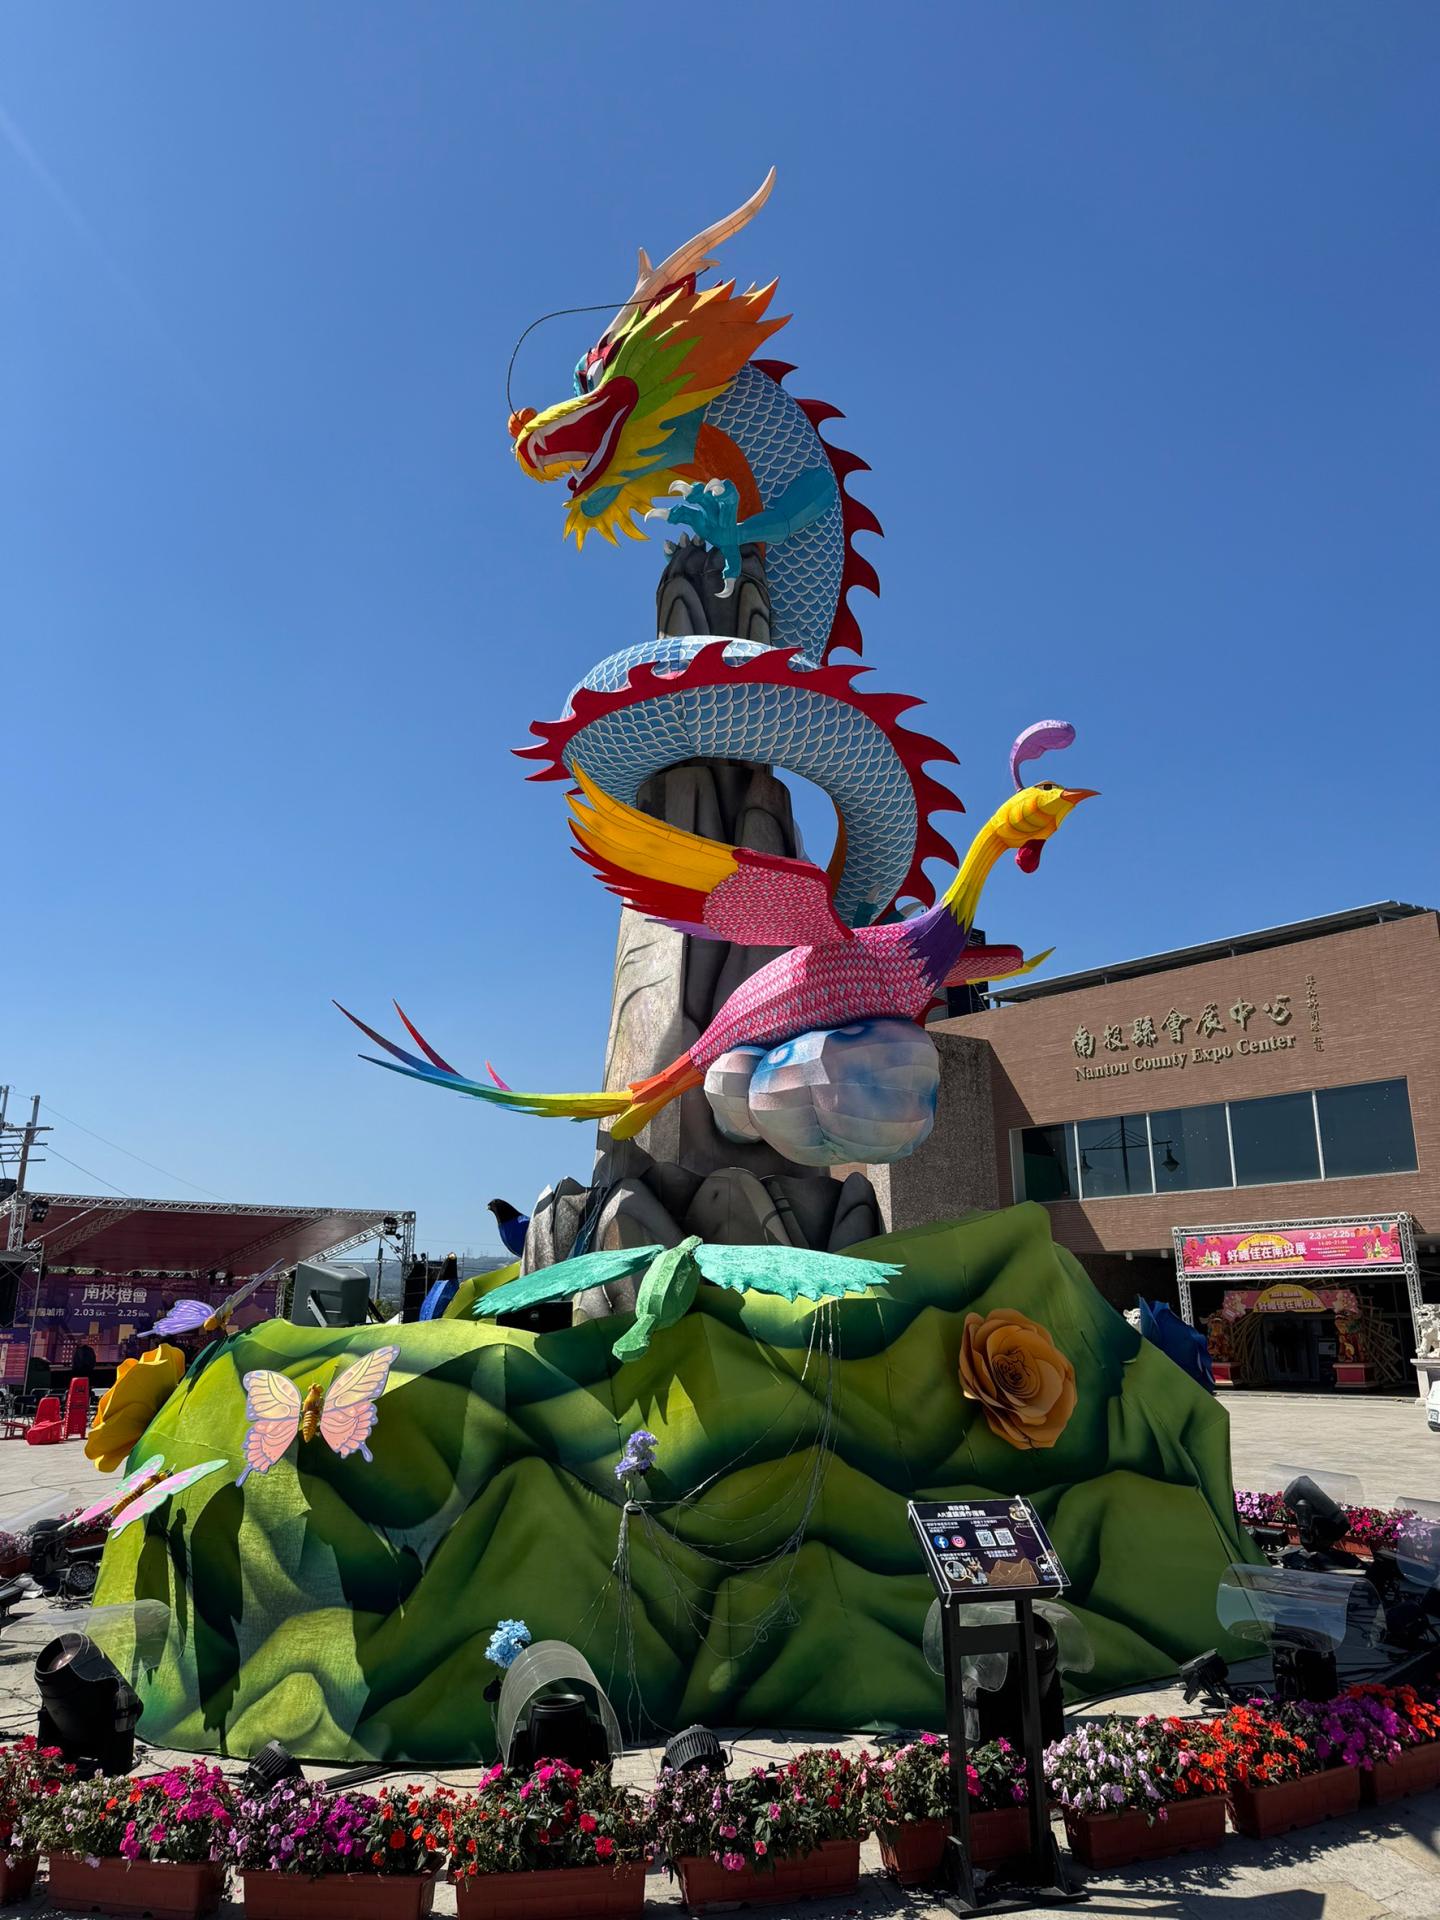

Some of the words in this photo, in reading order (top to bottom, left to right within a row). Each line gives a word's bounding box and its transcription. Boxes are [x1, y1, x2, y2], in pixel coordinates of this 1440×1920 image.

[1072, 994, 1293, 1058] 南投縣會展中心
[1075, 1062, 1130, 1081] Nantou
[1132, 1049, 1188, 1071] County
[1191, 1046, 1233, 1066] Expo
[1236, 1033, 1297, 1055] Center
[81, 1283, 148, 1306] 南投燈會
[74, 1308, 95, 1316] 2.03
[117, 1308, 138, 1317] 2.25
